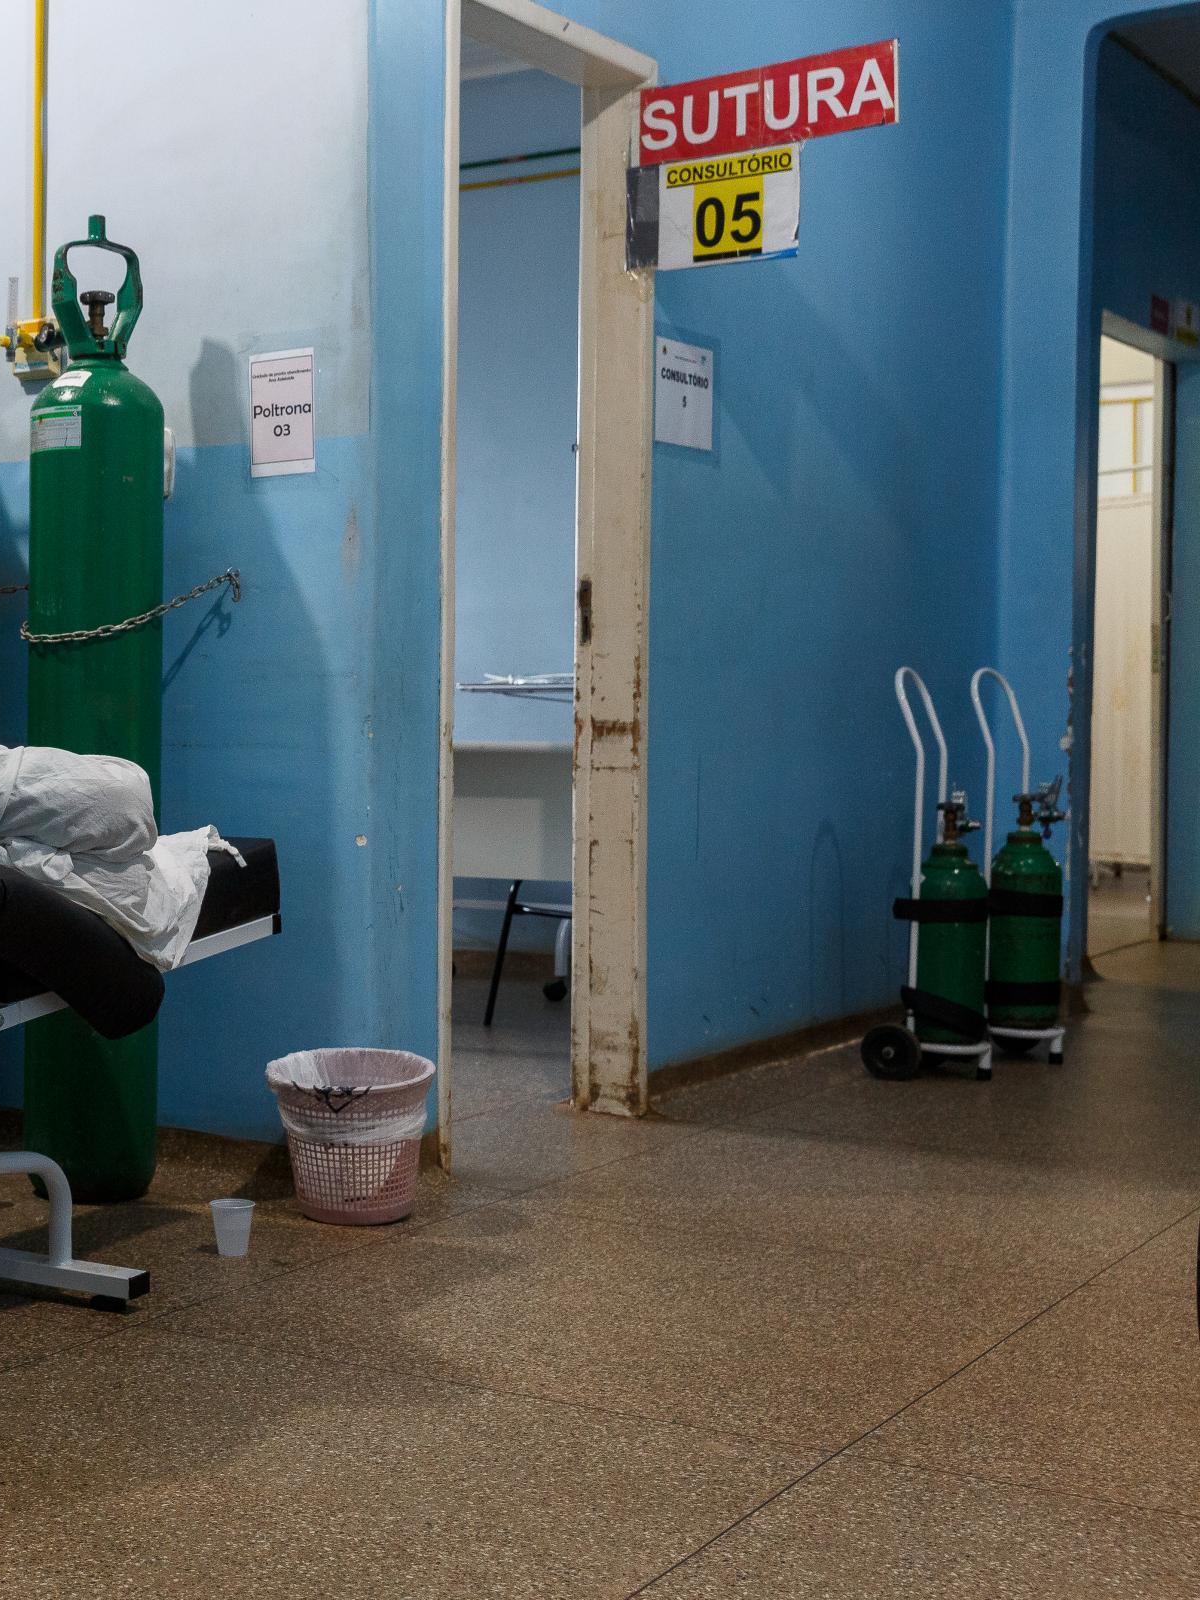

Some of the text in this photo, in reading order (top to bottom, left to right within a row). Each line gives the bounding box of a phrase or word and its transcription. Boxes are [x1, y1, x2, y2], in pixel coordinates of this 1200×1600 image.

[640, 57, 895, 151] SUTURA
[666, 152, 793, 185] CONSULTÓRIO
[695, 191, 762, 248] 05
[661, 367, 709, 389] CONSULTÓRIO
[253, 403, 312, 419] Poltrona
[273, 424, 291, 437] 03
